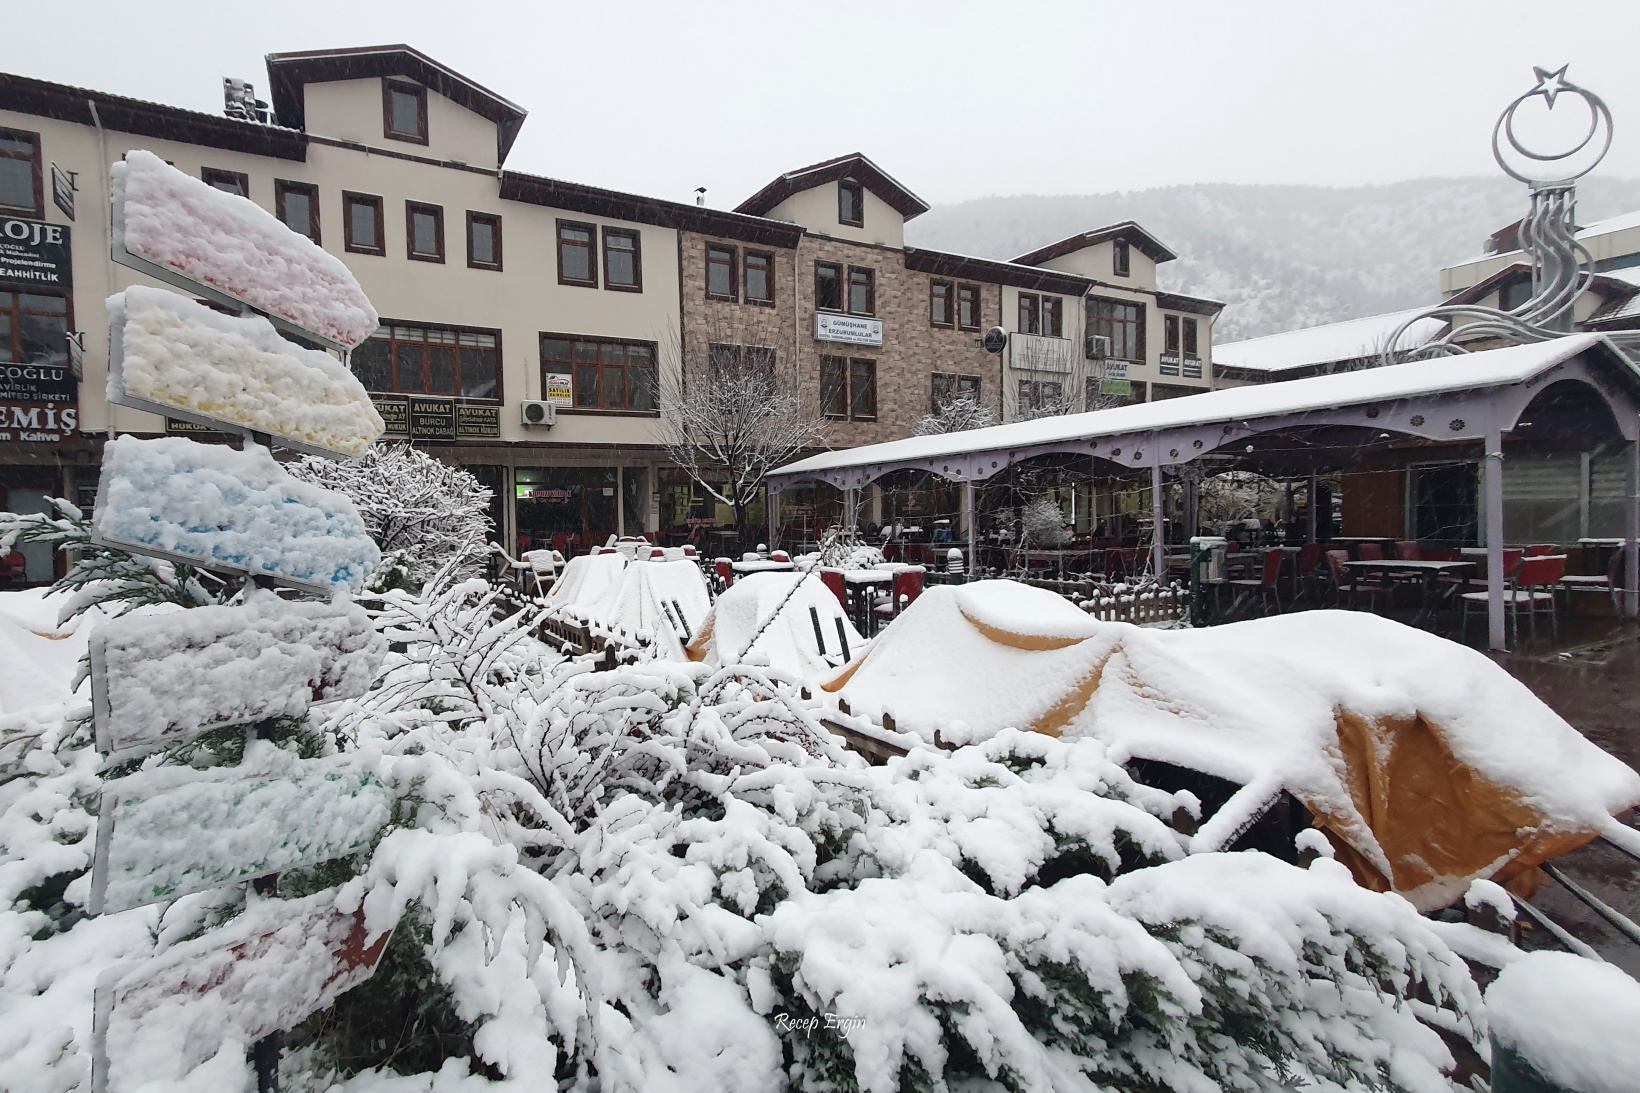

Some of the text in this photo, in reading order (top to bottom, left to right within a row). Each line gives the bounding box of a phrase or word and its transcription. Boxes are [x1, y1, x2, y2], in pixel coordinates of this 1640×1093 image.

[833, 320, 868, 329] GÜMÜŞHANE
[828, 328, 873, 337] ERZURUMLULAR
[414, 403, 451, 413] AVUKAT
[459, 408, 497, 417] AVUKAT
[419, 417, 446, 425] BURCU
[20, 432, 60, 442] Kahve
